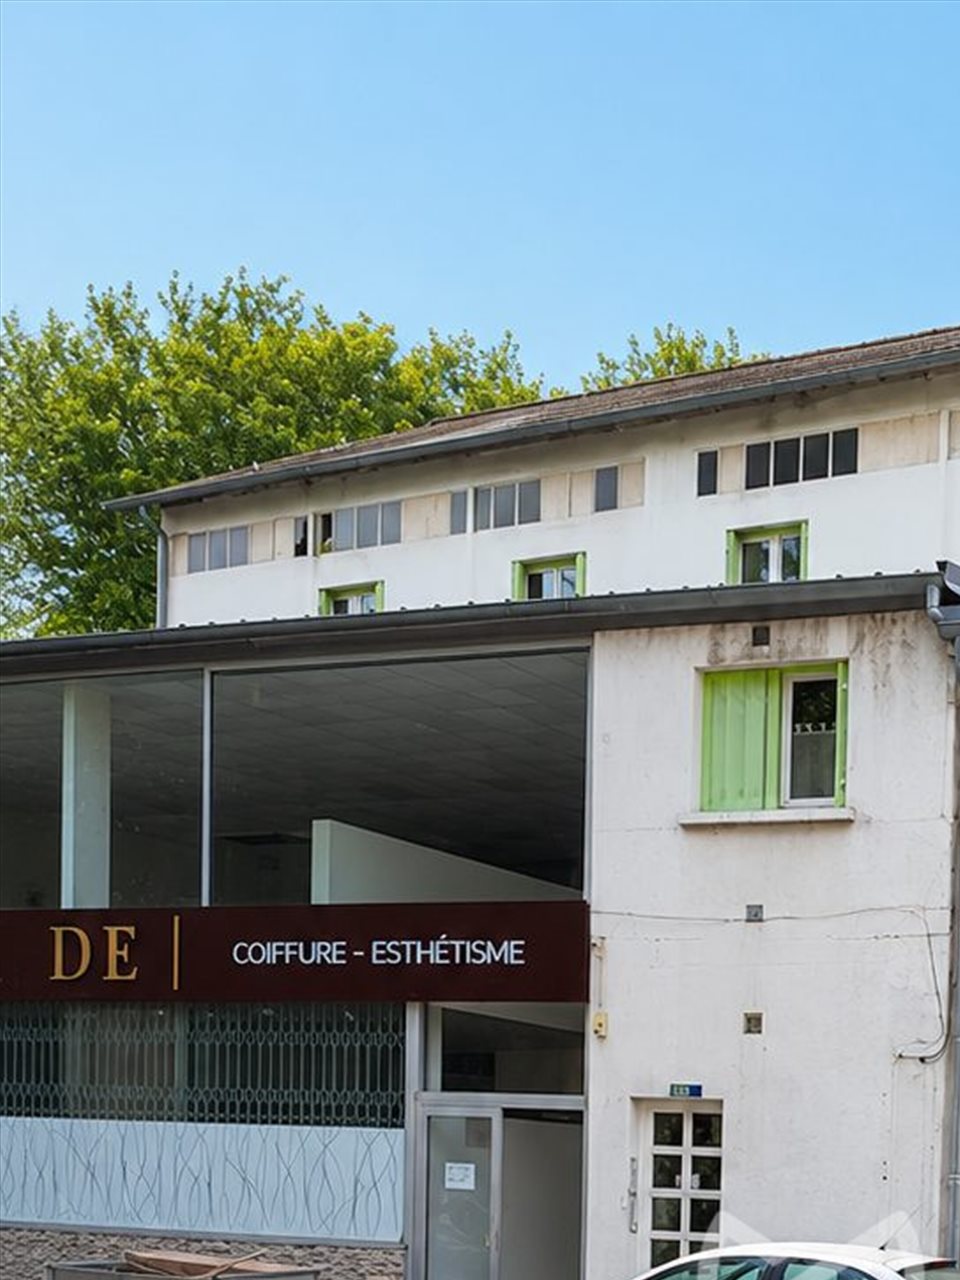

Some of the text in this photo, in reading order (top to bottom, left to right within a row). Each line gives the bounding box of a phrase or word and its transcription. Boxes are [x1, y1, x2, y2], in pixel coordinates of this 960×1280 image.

[49, 925, 138, 981] DE
[232, 940, 347, 965] COIFFURE
[371, 934, 525, 965] ESTHÉTISME
